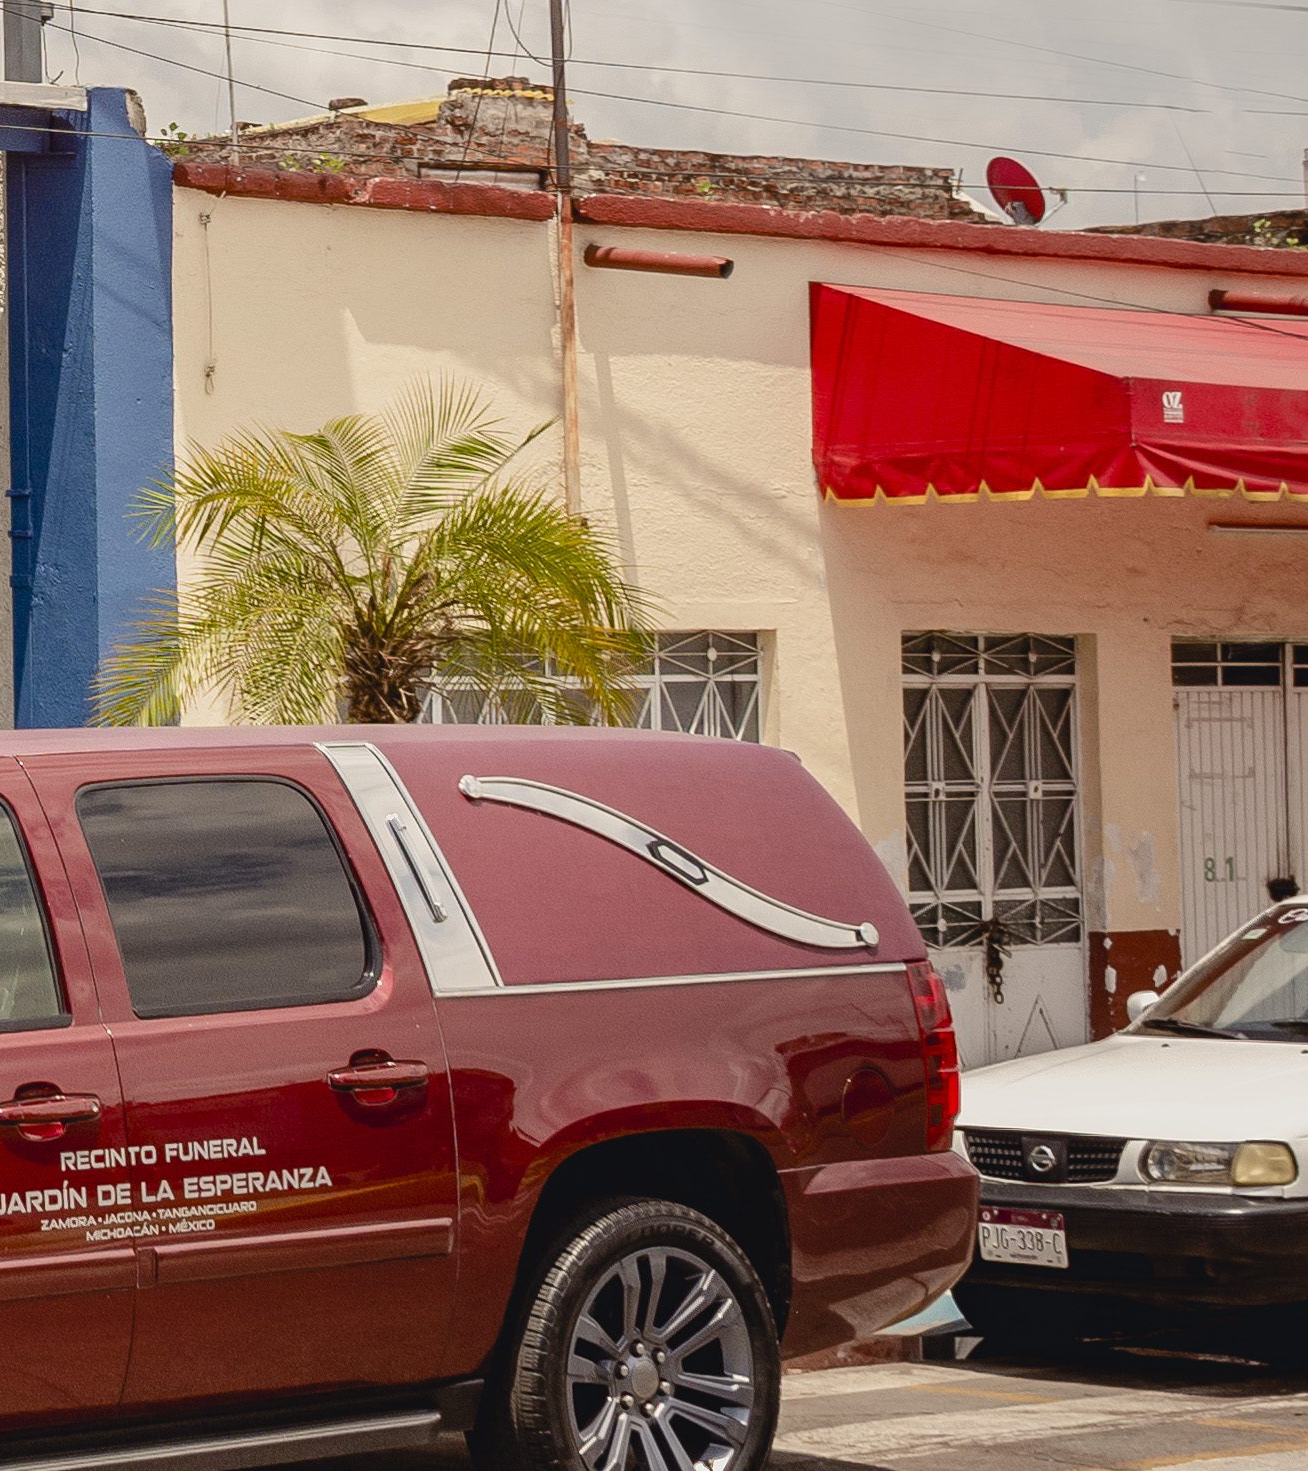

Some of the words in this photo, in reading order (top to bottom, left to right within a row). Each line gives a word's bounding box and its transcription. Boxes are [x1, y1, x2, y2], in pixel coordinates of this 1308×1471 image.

[59, 1145, 158, 1173] RECINTO
[164, 1135, 267, 1164] FUNERAL
[96, 1182, 132, 1207] DE
[140, 1178, 176, 1204] LA
[183, 1165, 333, 1200] ESPERANZA
[40, 1214, 97, 1232] ZAMORA
[103, 1209, 152, 1226] JACONA
[85, 1222, 160, 1242] MICHOACÁN
[168, 1218, 216, 1235] MÉXICO
[981, 1225, 1064, 1255] PJG-338-C
